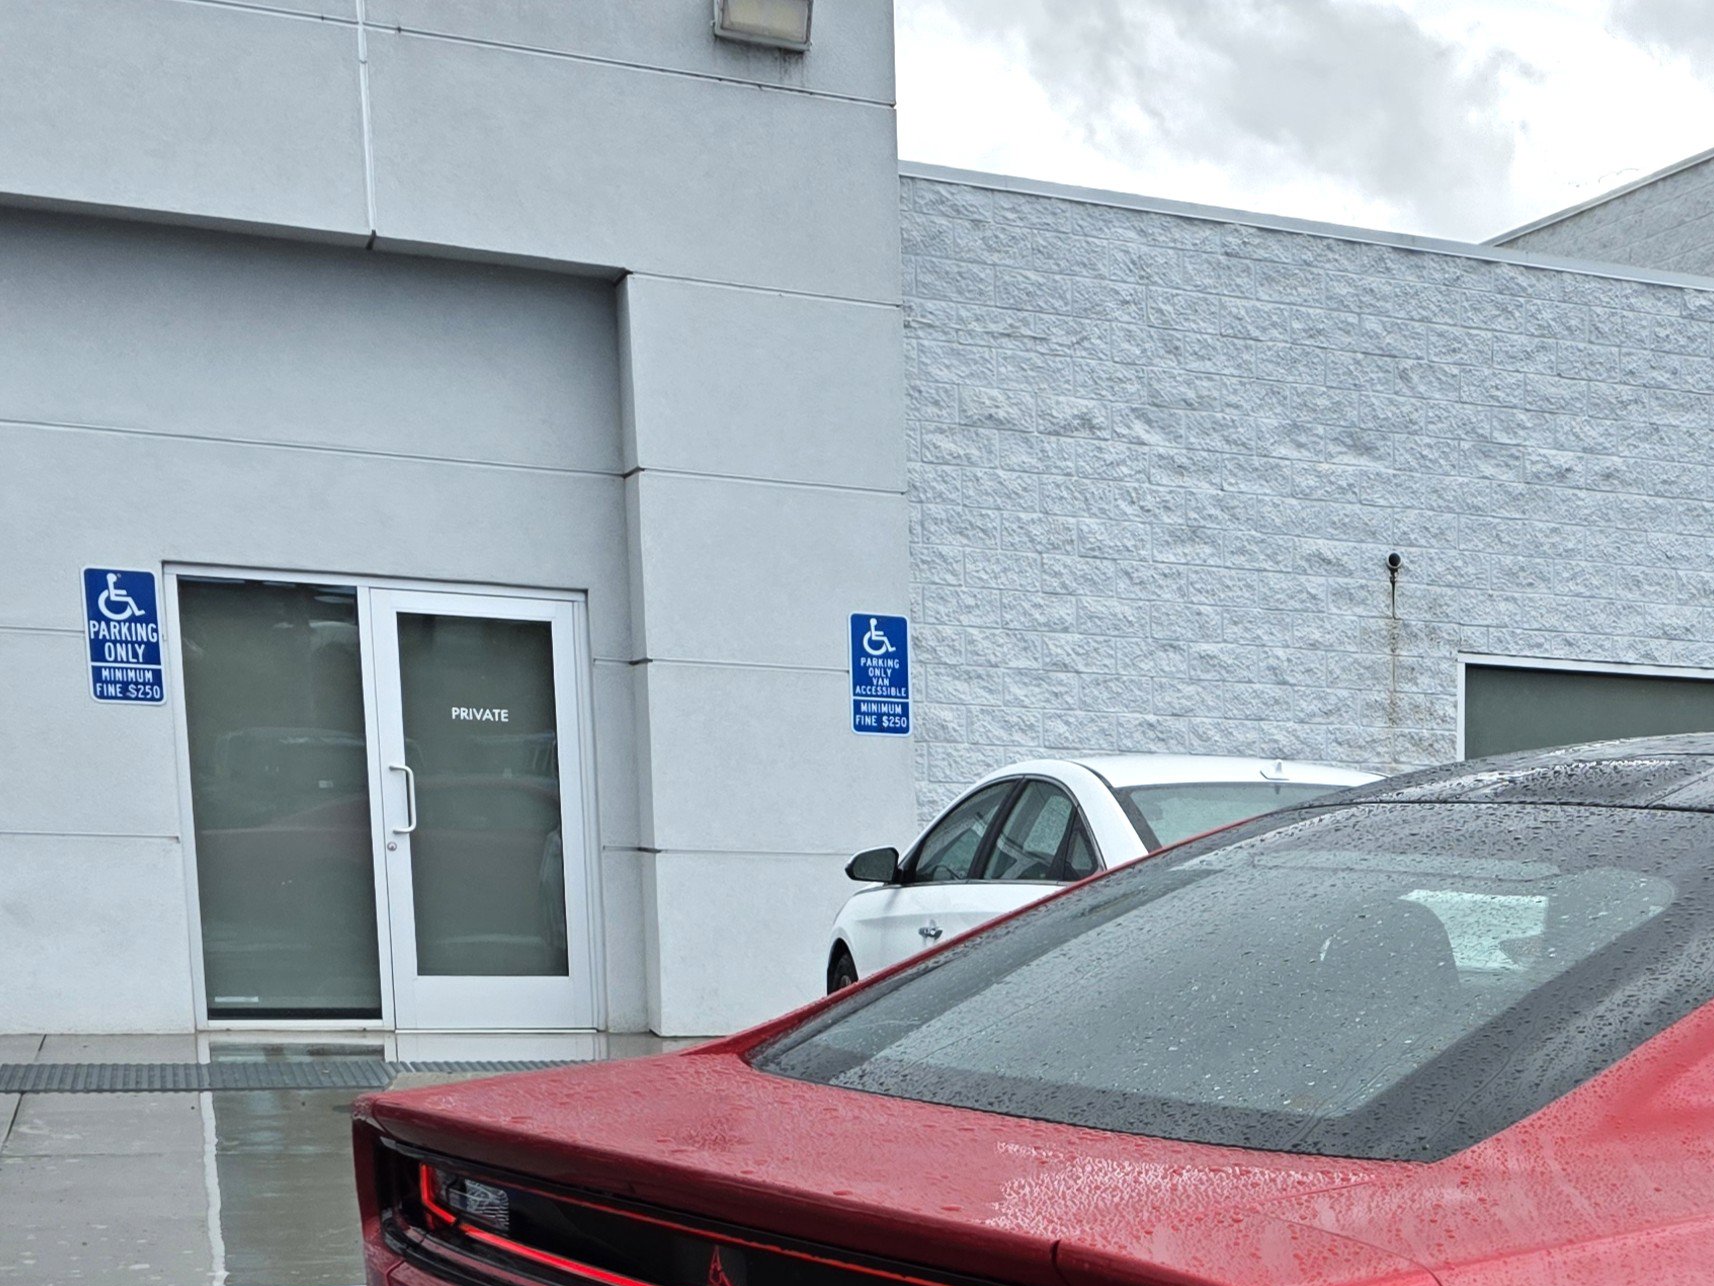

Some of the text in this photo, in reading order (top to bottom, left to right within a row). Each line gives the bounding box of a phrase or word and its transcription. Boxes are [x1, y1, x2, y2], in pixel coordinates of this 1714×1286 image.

[89, 620, 158, 643] PARKING
[104, 642, 145, 662] ONLY
[860, 657, 900, 669] PARKING
[102, 668, 153, 682] MINIMUM
[868, 667, 892, 678] ONLY
[872, 677, 889, 686] VAN
[96, 683, 160, 699] FINE $250
[855, 685, 906, 697] ACCESSIBLE
[860, 702, 902, 714] MINIMUM
[451, 707, 509, 722] PRIVATE
[856, 715, 907, 727] FINE $250
